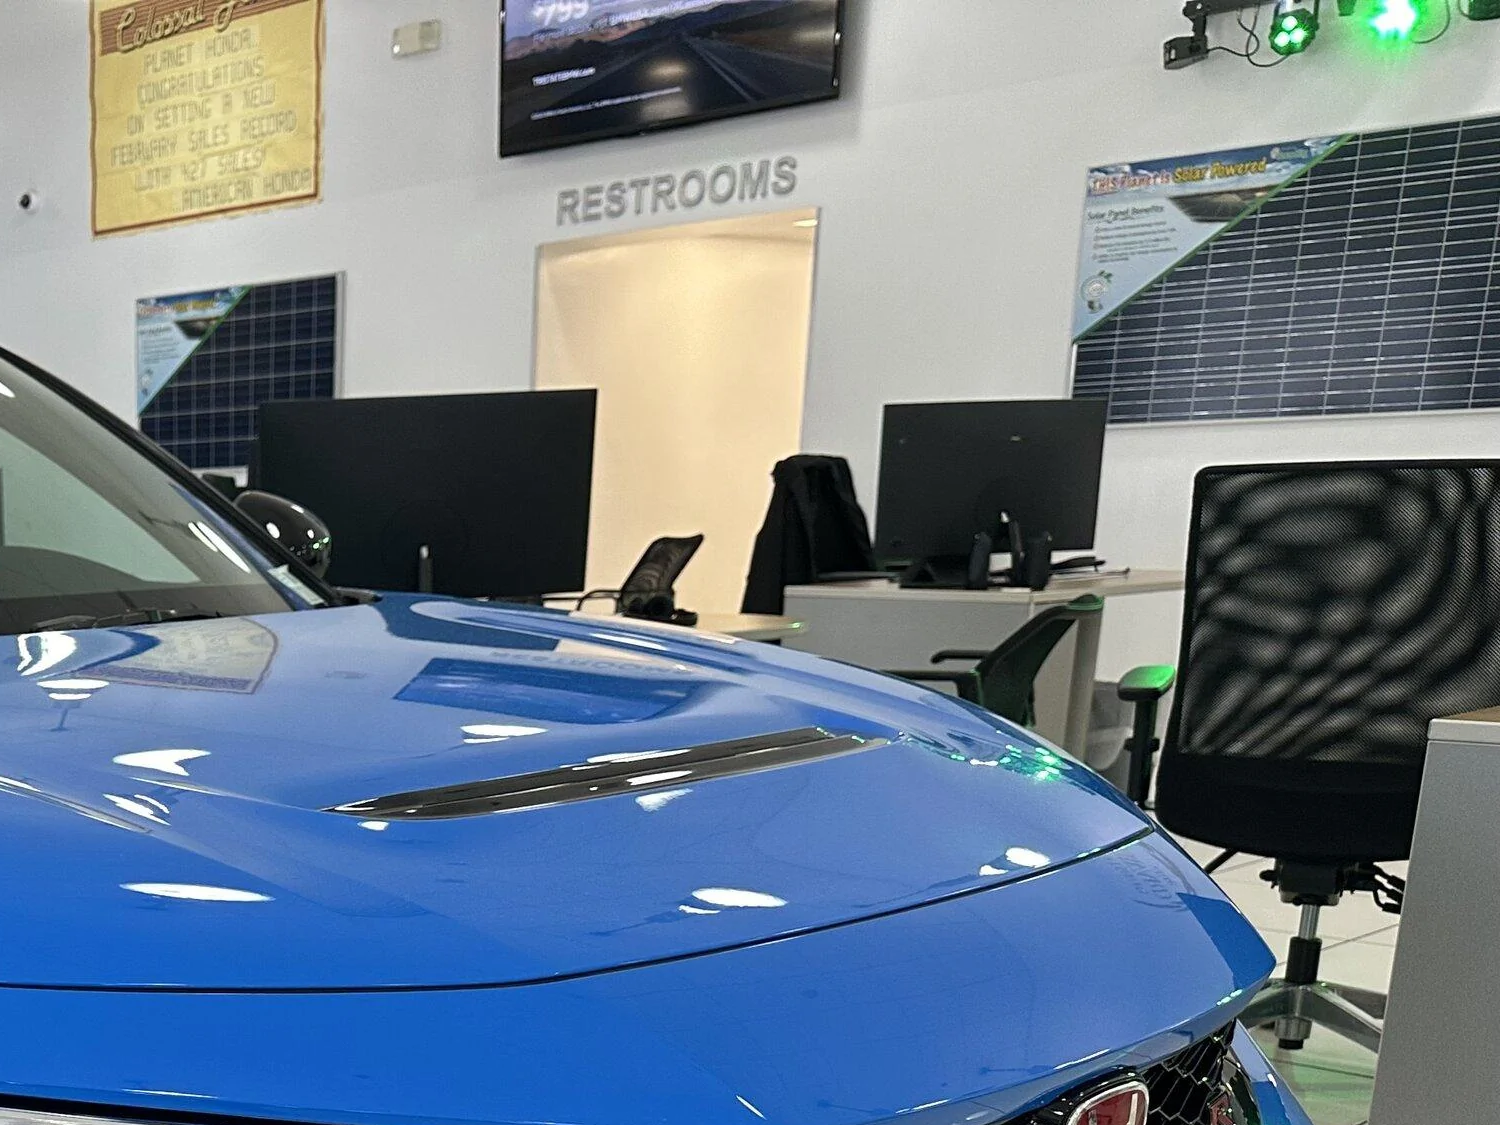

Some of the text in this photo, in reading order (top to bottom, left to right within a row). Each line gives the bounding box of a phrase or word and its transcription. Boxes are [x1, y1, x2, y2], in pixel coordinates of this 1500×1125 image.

[117, 3, 206, 53] Colossal
[143, 42, 193, 74] PLANET
[137, 56, 265, 109] CONGRATULATIONS
[187, 123, 230, 152] SALES
[239, 109, 297, 141] RECORD
[262, 168, 312, 195] HONDA
[556, 156, 797, 226] RESTROOMS
